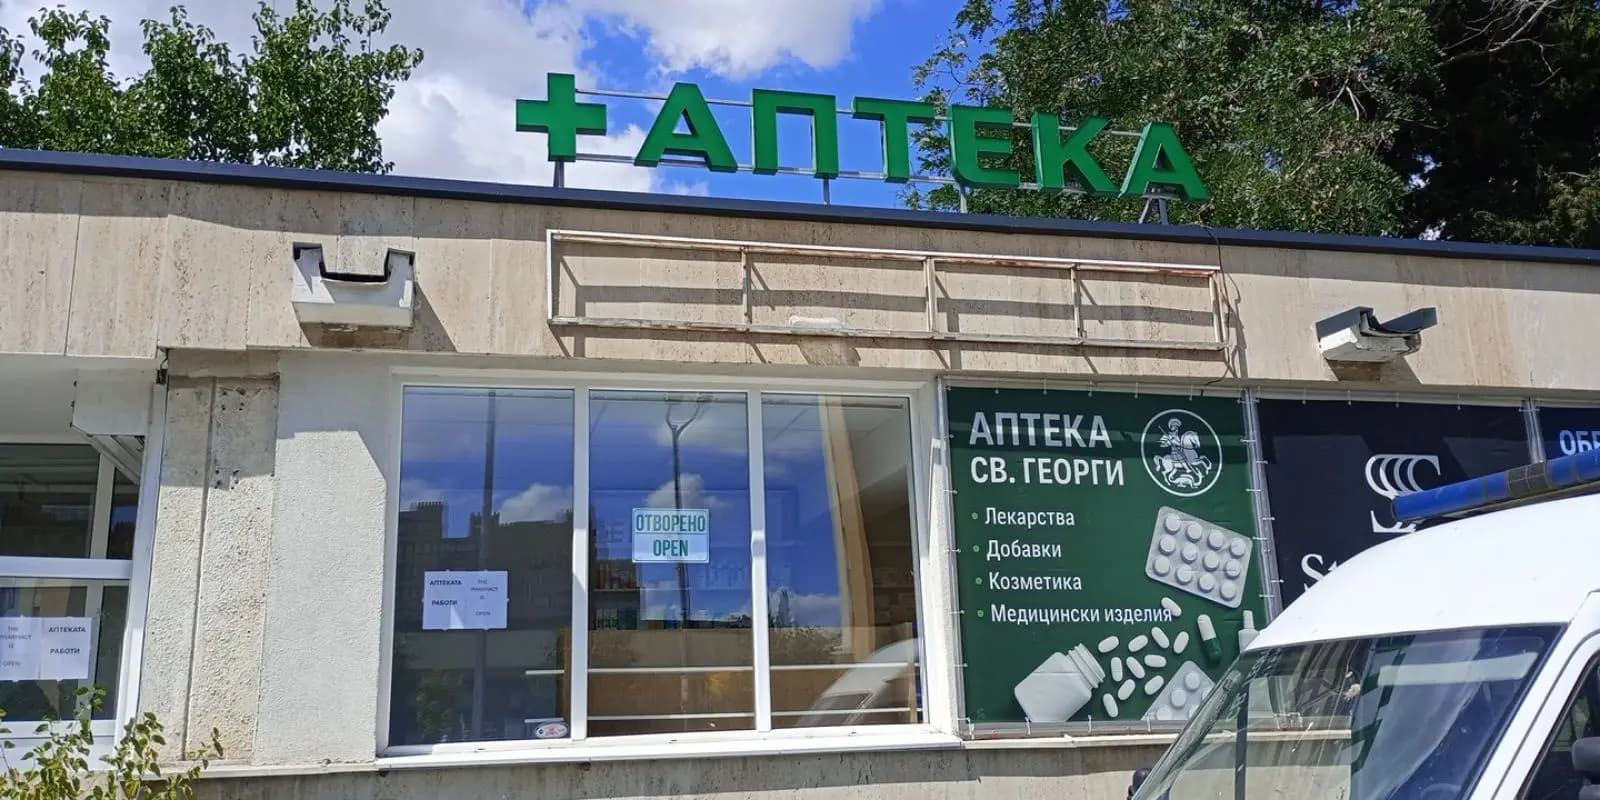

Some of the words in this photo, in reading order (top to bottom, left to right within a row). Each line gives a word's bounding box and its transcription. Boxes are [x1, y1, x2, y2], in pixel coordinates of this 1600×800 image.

[634, 82, 1211, 199] АПТЕКА
[969, 411, 1113, 448] АПТЕКА
[970, 456, 1016, 483] СВ.
[1022, 457, 1125, 486] ГЕОРГИ
[635, 514, 706, 532] ОТВОРЕНО
[984, 507, 1075, 529] Лекарства
[652, 539, 689, 557] OPEN
[986, 540, 1062, 561] Добавки
[988, 571, 1082, 590] Козметика
[990, 604, 1101, 625] Медицински
[1104, 607, 1172, 625] изделия
[49, 647, 81, 655] РАБОТИ
